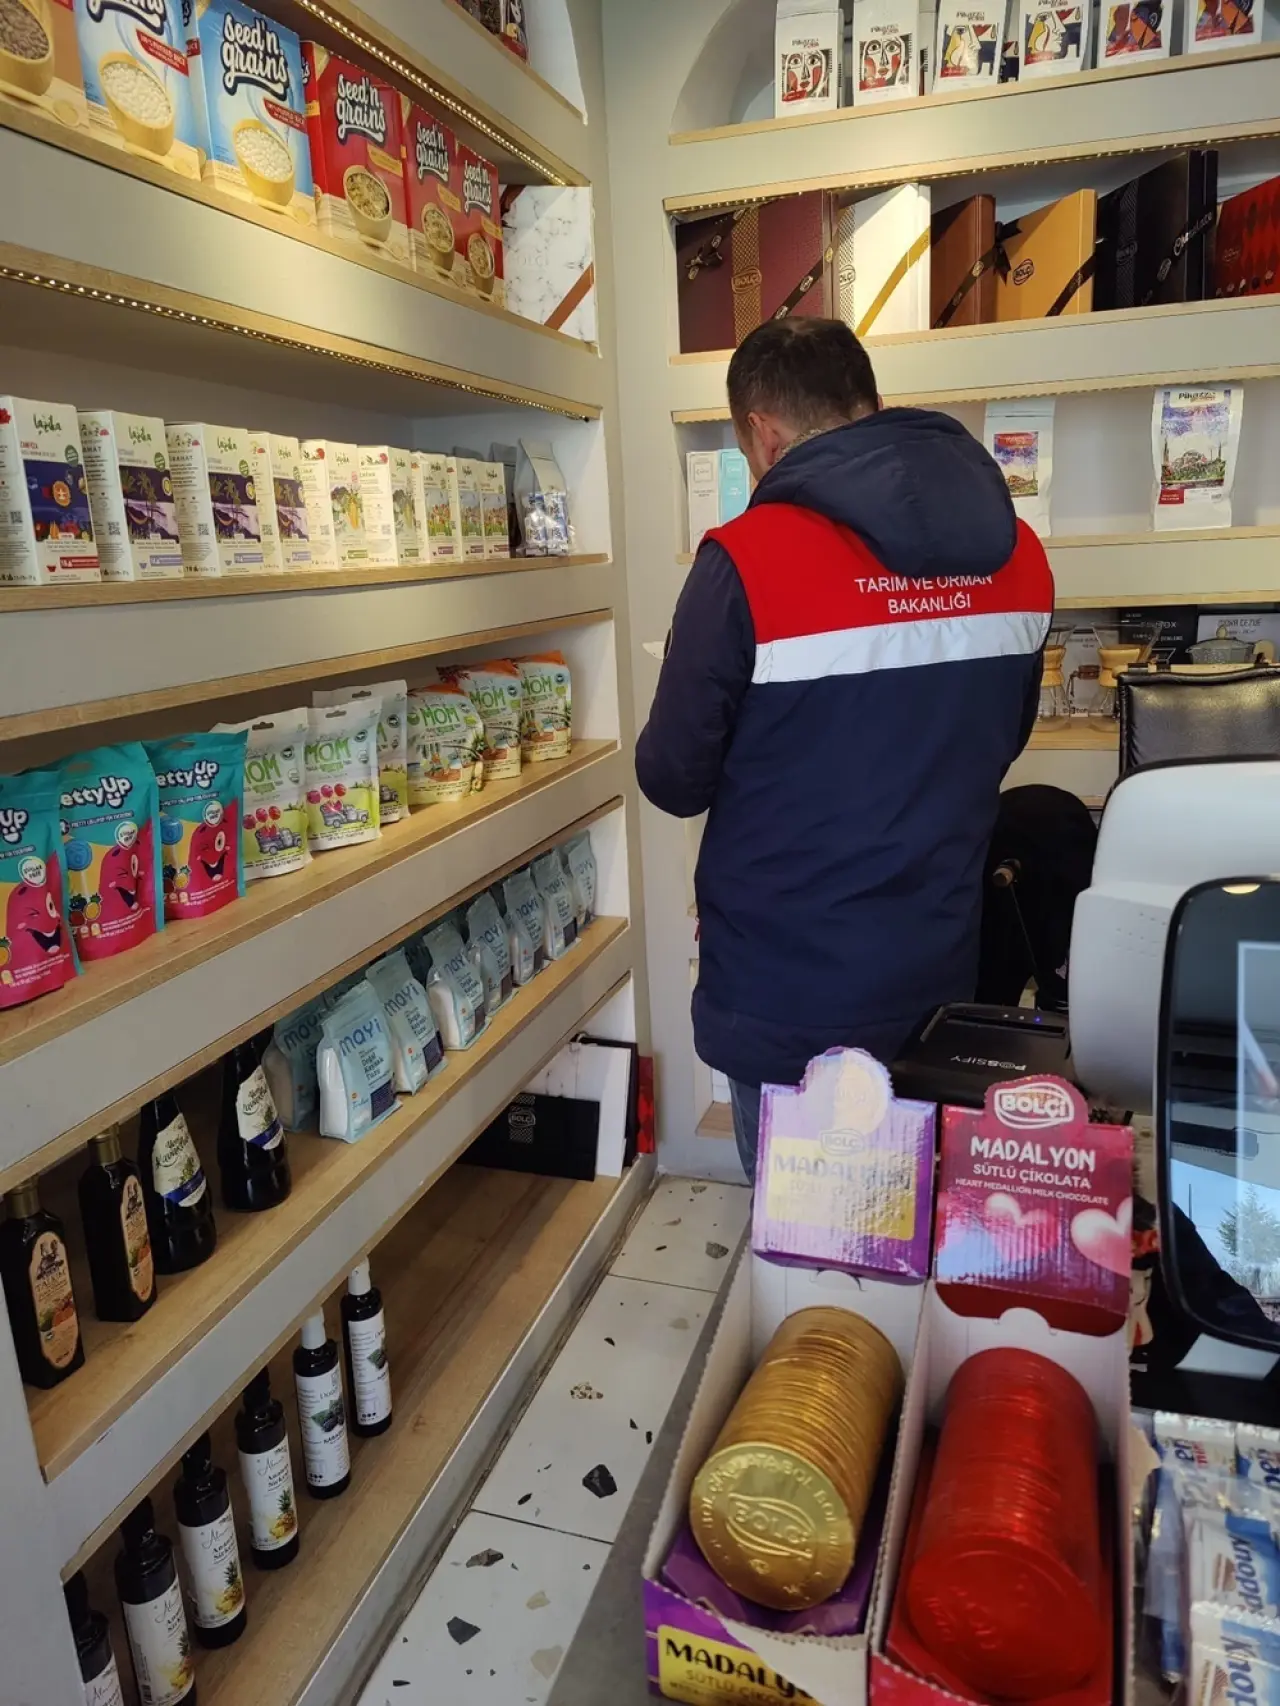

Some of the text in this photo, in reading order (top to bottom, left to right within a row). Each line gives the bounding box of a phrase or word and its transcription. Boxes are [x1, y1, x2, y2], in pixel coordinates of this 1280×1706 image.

[854, 573, 993, 594] TARIM VE ORMAN
[887, 591, 972, 614] BAKANLIĞI
[420, 706, 460, 727] MOM
[304, 737, 352, 766] MOM
[339, 1017, 382, 1057] mayi
[970, 1136, 1096, 1173] MADALYON
[973, 1162, 1092, 1190] SÜTLÜ ÇİKOLATA
[955, 1178, 1110, 1206] HEART MEDALLION MILK CHOCOLATE
[666, 1638, 814, 1699] MADALY
